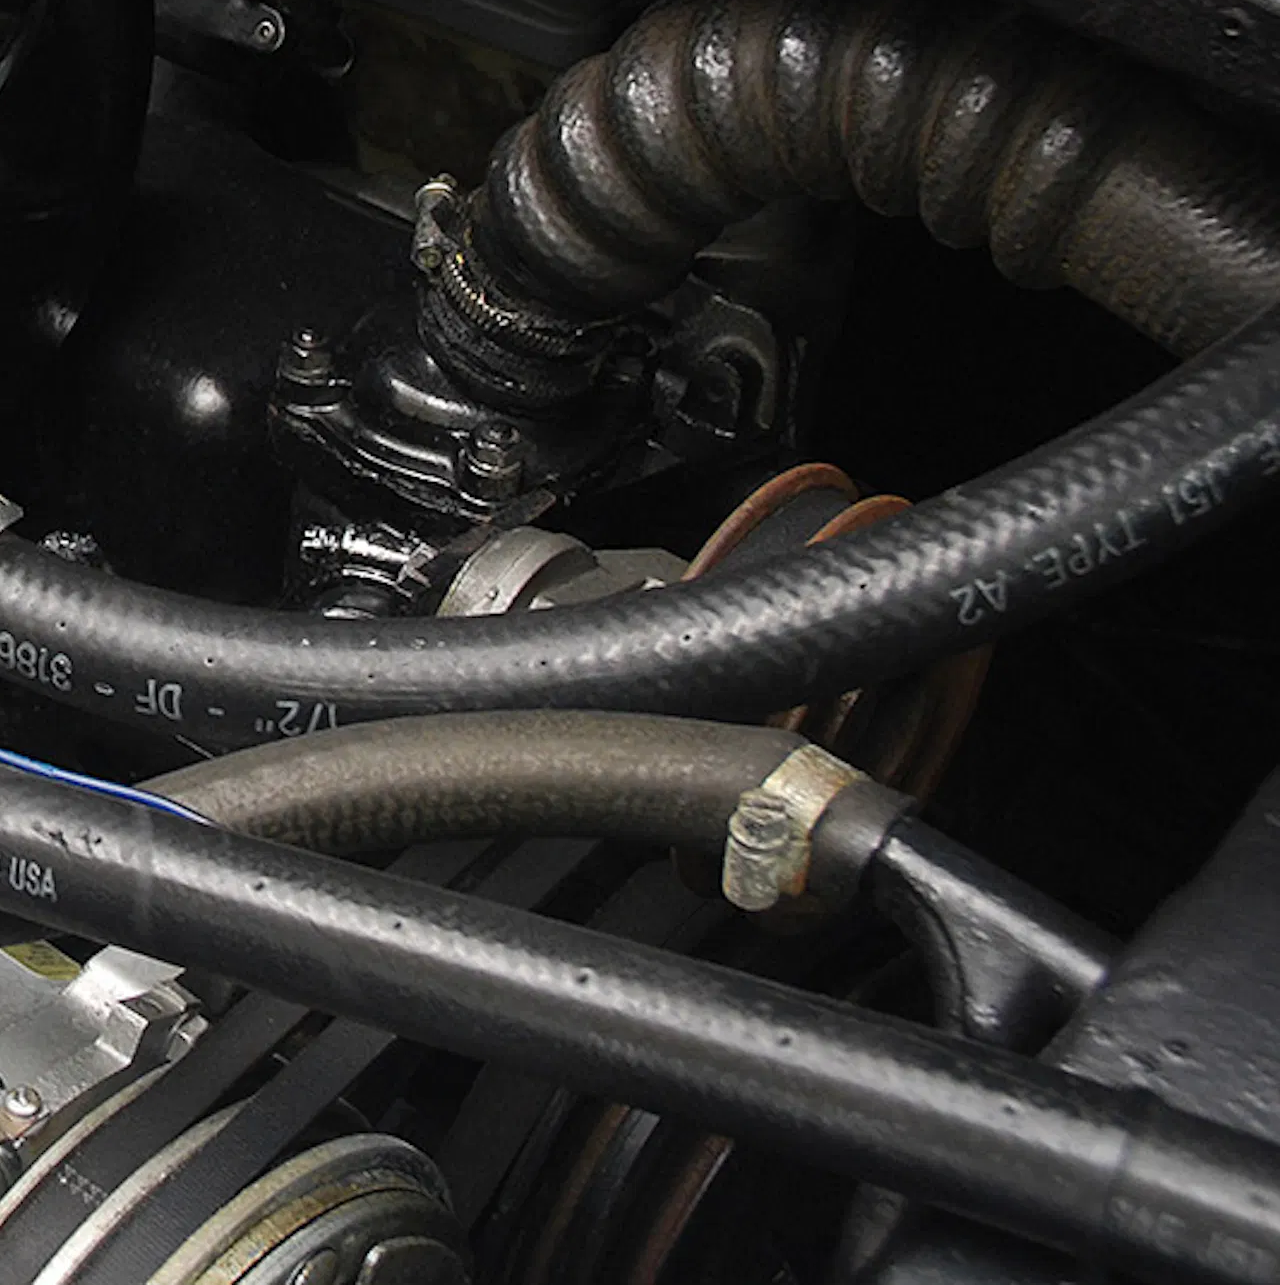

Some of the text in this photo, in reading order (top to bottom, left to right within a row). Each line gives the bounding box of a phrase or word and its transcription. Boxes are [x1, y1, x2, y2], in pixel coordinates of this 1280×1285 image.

[1032, 509, 1147, 589] TYPE
[949, 569, 1008, 626] A2
[135, 677, 184, 721] DF
[8, 856, 59, 903] USA
